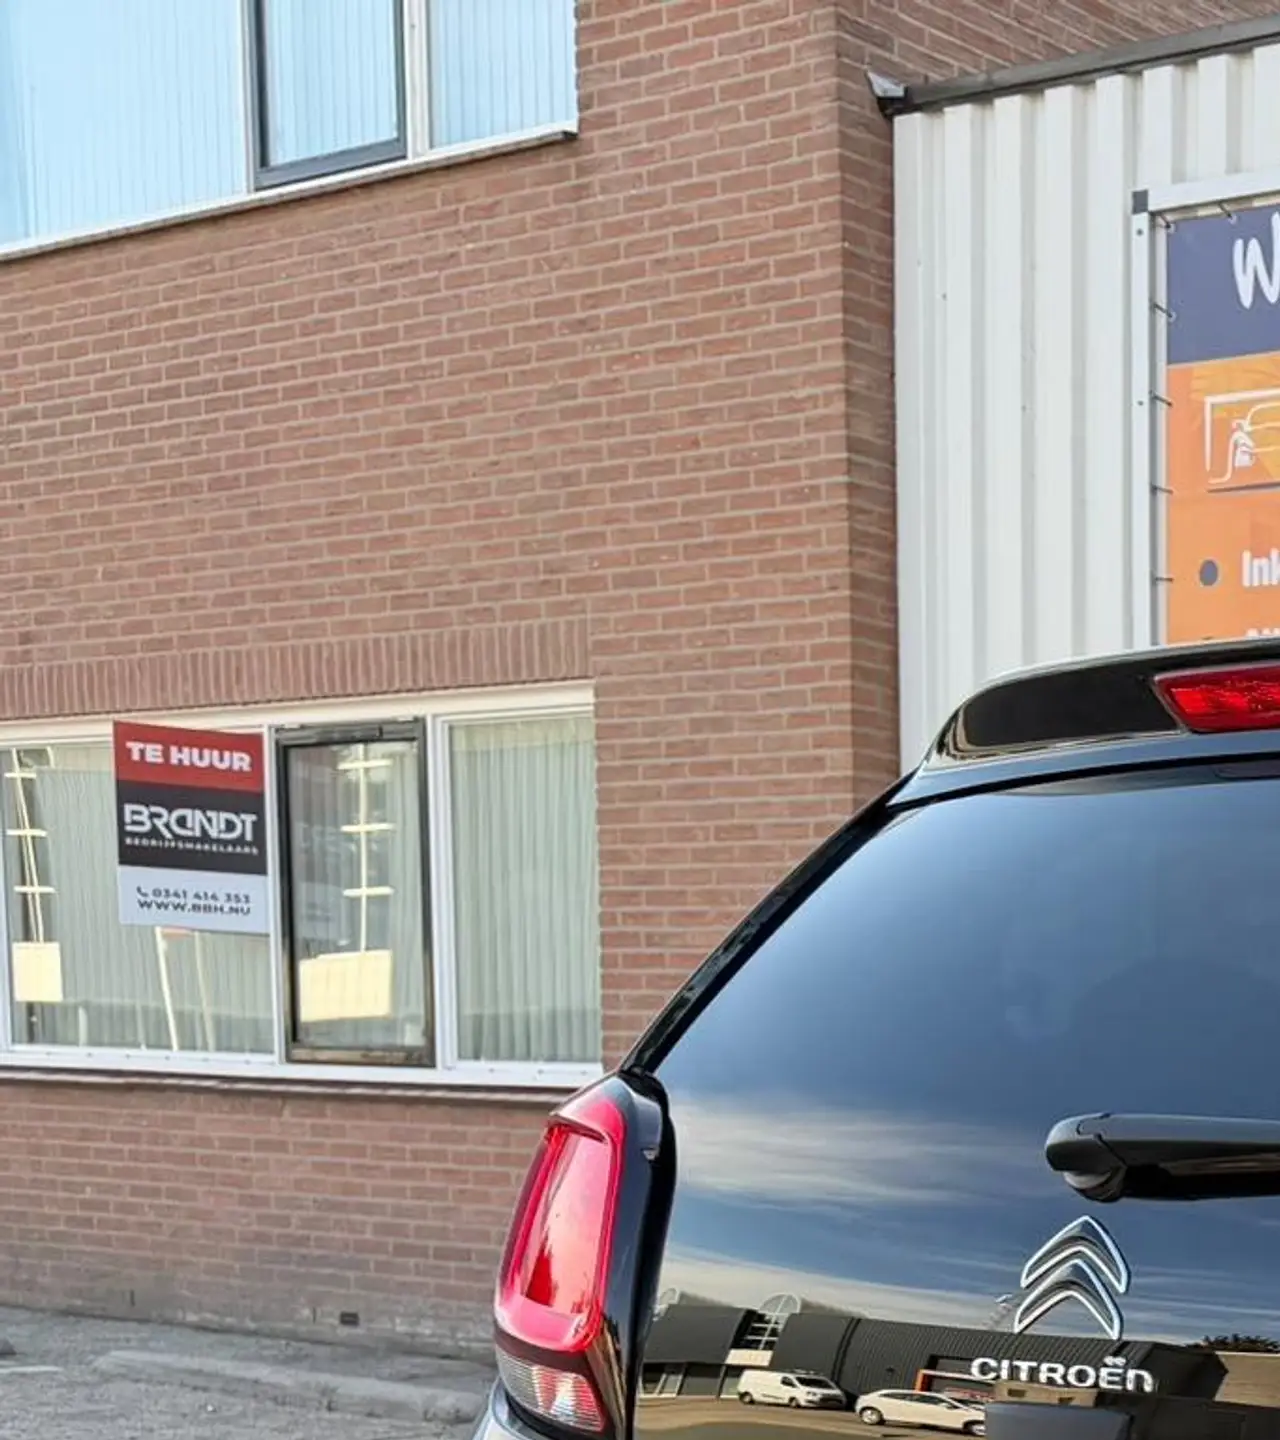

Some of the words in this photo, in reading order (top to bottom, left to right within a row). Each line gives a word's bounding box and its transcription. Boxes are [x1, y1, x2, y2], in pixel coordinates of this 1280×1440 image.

[125, 740, 165, 764] TE
[169, 745, 252, 771] HUUR
[123, 802, 258, 842] BRANDT
